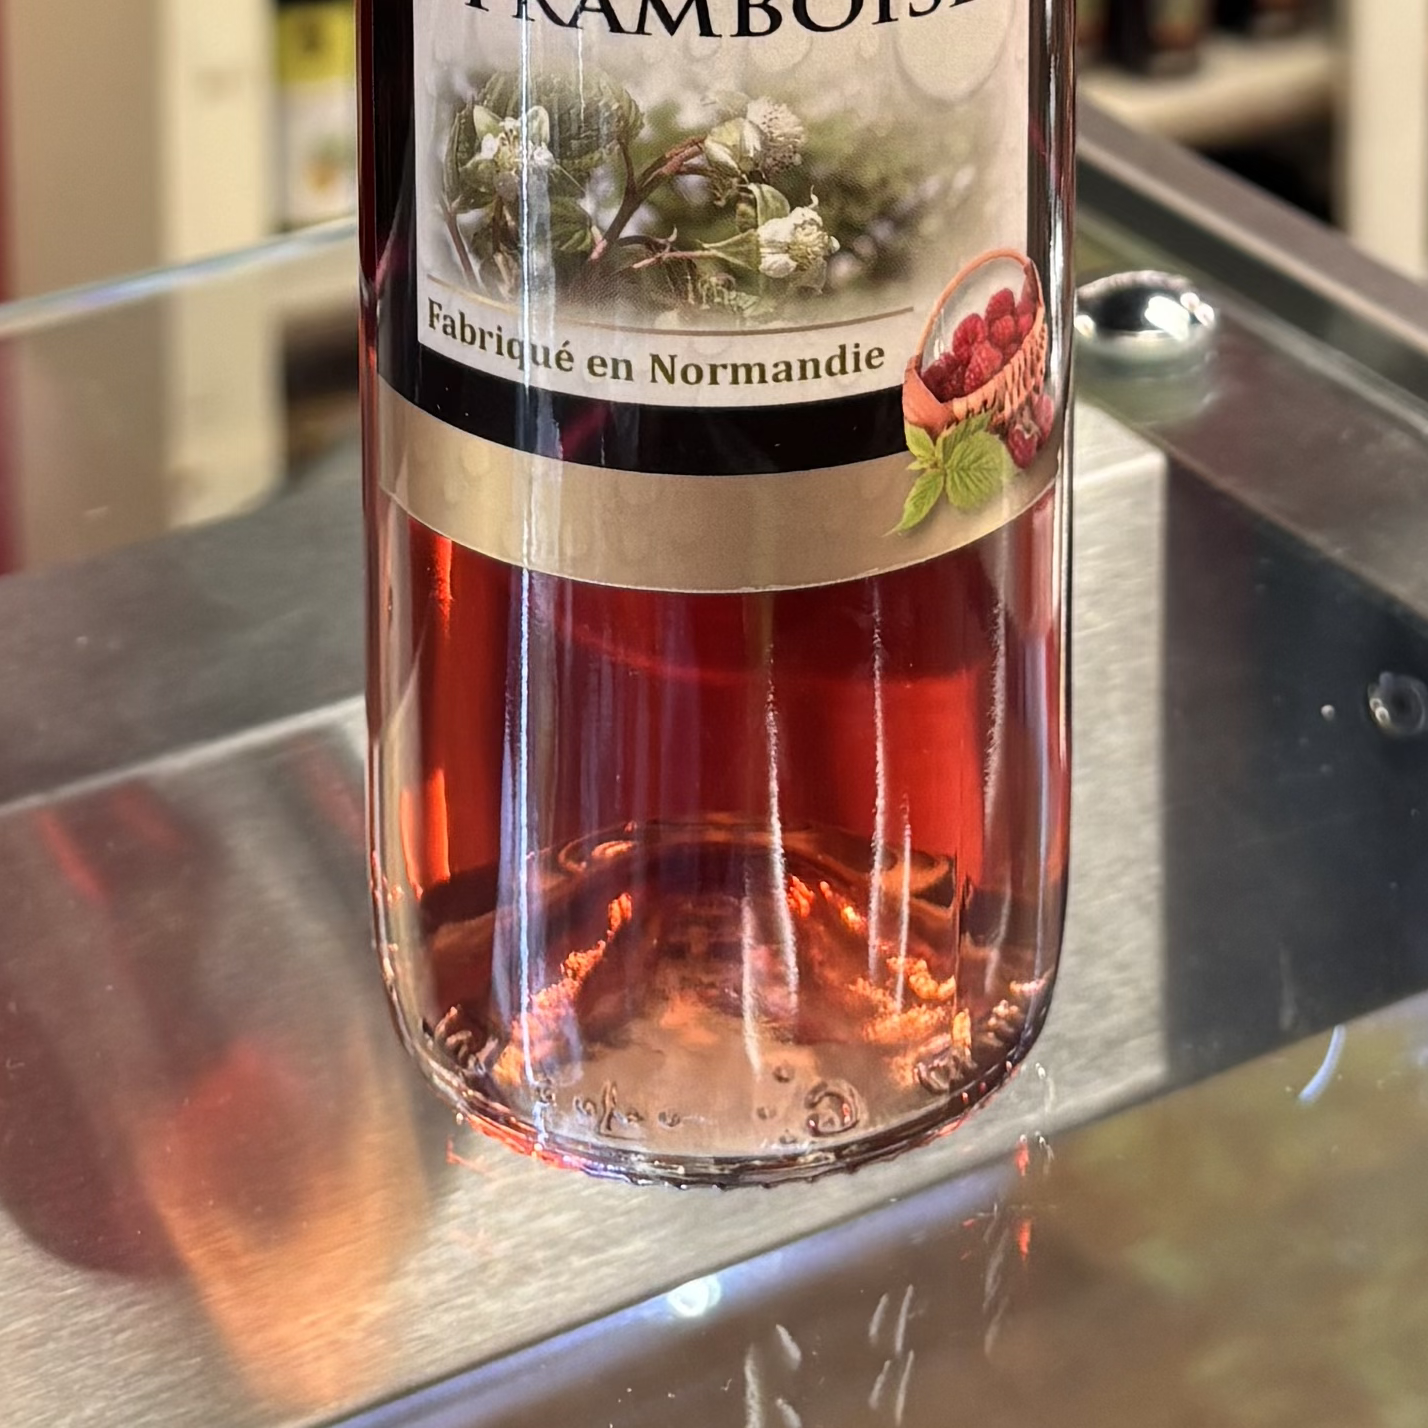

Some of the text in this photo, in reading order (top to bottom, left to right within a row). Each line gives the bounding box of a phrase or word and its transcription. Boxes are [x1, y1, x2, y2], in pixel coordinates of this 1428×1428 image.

[427, 298, 886, 386] Fabriqué en Normandie
